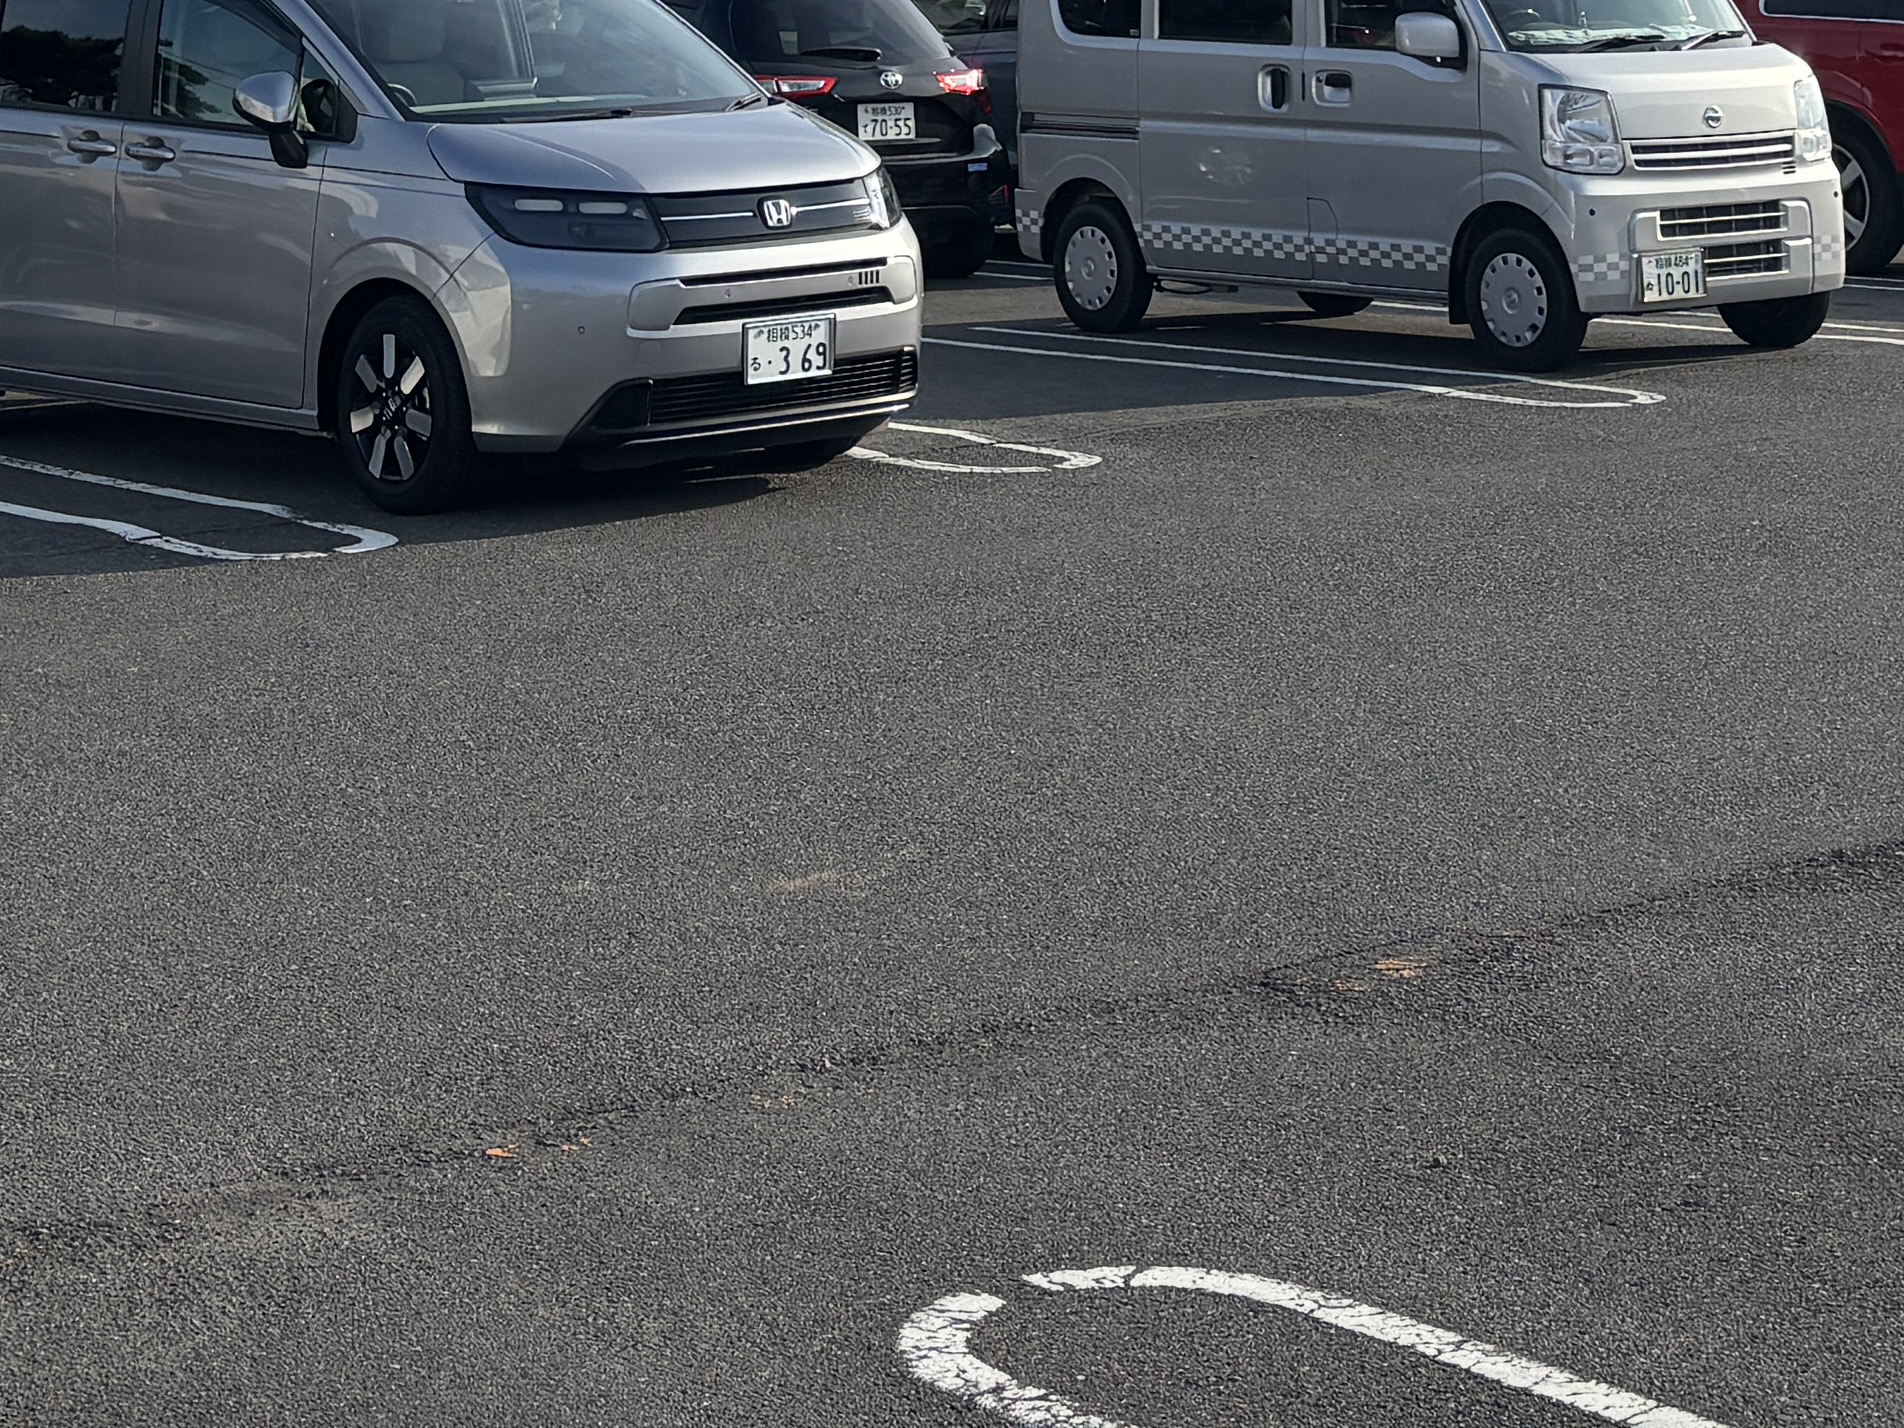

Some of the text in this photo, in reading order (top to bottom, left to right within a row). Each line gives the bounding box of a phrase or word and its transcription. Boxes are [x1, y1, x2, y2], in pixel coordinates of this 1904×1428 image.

[870, 118, 912, 137] 70-55
[1658, 269, 1699, 297] 10-01
[779, 342, 827, 375] 369
